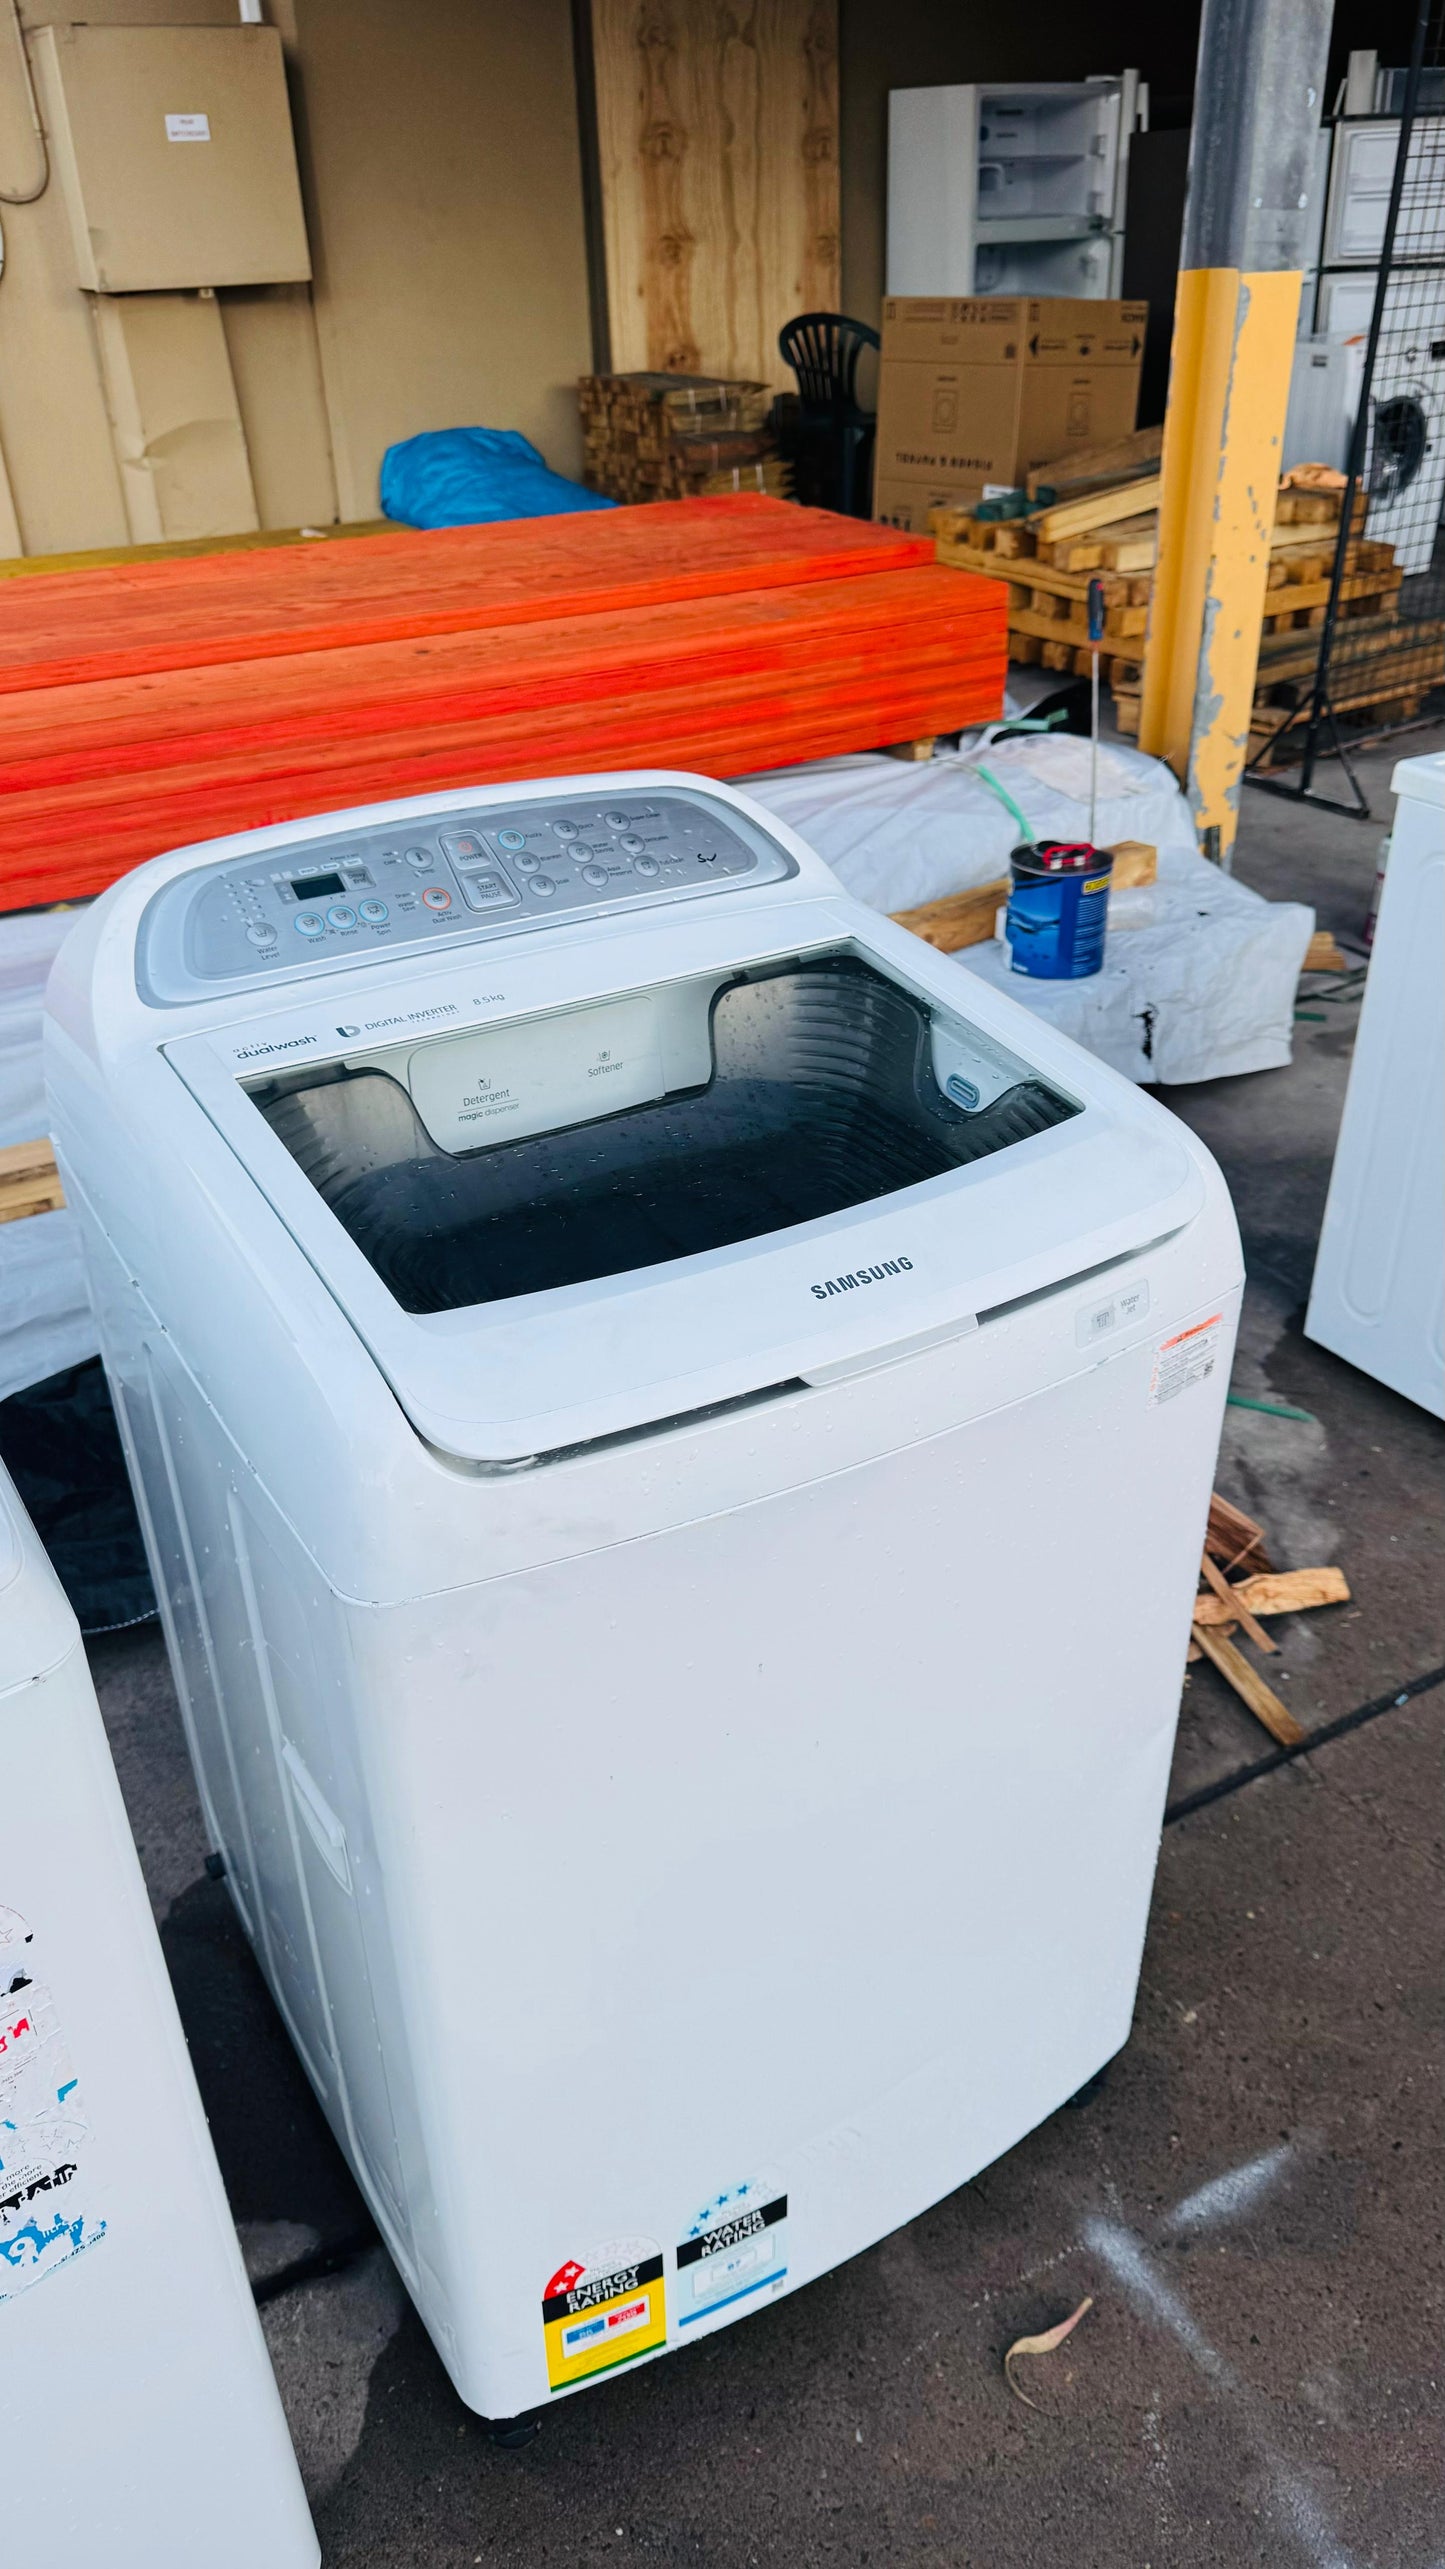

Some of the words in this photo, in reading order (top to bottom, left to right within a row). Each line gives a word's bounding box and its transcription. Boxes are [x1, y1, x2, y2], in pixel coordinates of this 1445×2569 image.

[459, 853, 482, 861] POWER
[477, 882, 497, 891] START
[481, 891, 502, 900] PAUSE
[340, 928, 358, 936] Rinse
[370, 922, 391, 930] Power
[307, 935, 326, 944] Wash
[256, 945, 277, 955] Water
[261, 952, 280, 961] Level
[364, 1015, 407, 1031] DIGITAL
[407, 1004, 457, 1022] INVERTER
[237, 1035, 317, 1060] dualwash
[587, 1060, 624, 1078] Softener
[463, 1088, 511, 1107] Detergent
[458, 1110, 484, 1122] magic
[484, 1102, 520, 1117] dispenser
[810, 1256, 914, 1300] SAMSUNG
[1120, 1293, 1141, 1307] Water
[1126, 1304, 1137, 1315] Jet
[6, 2164, 30, 2182] more
[9, 2170, 44, 2194] efficient
[703, 2209, 764, 2244] WATER
[701, 2221, 766, 2258] RATING
[566, 2265, 640, 2304] ENERGY
[569, 2279, 639, 2314] RATING
